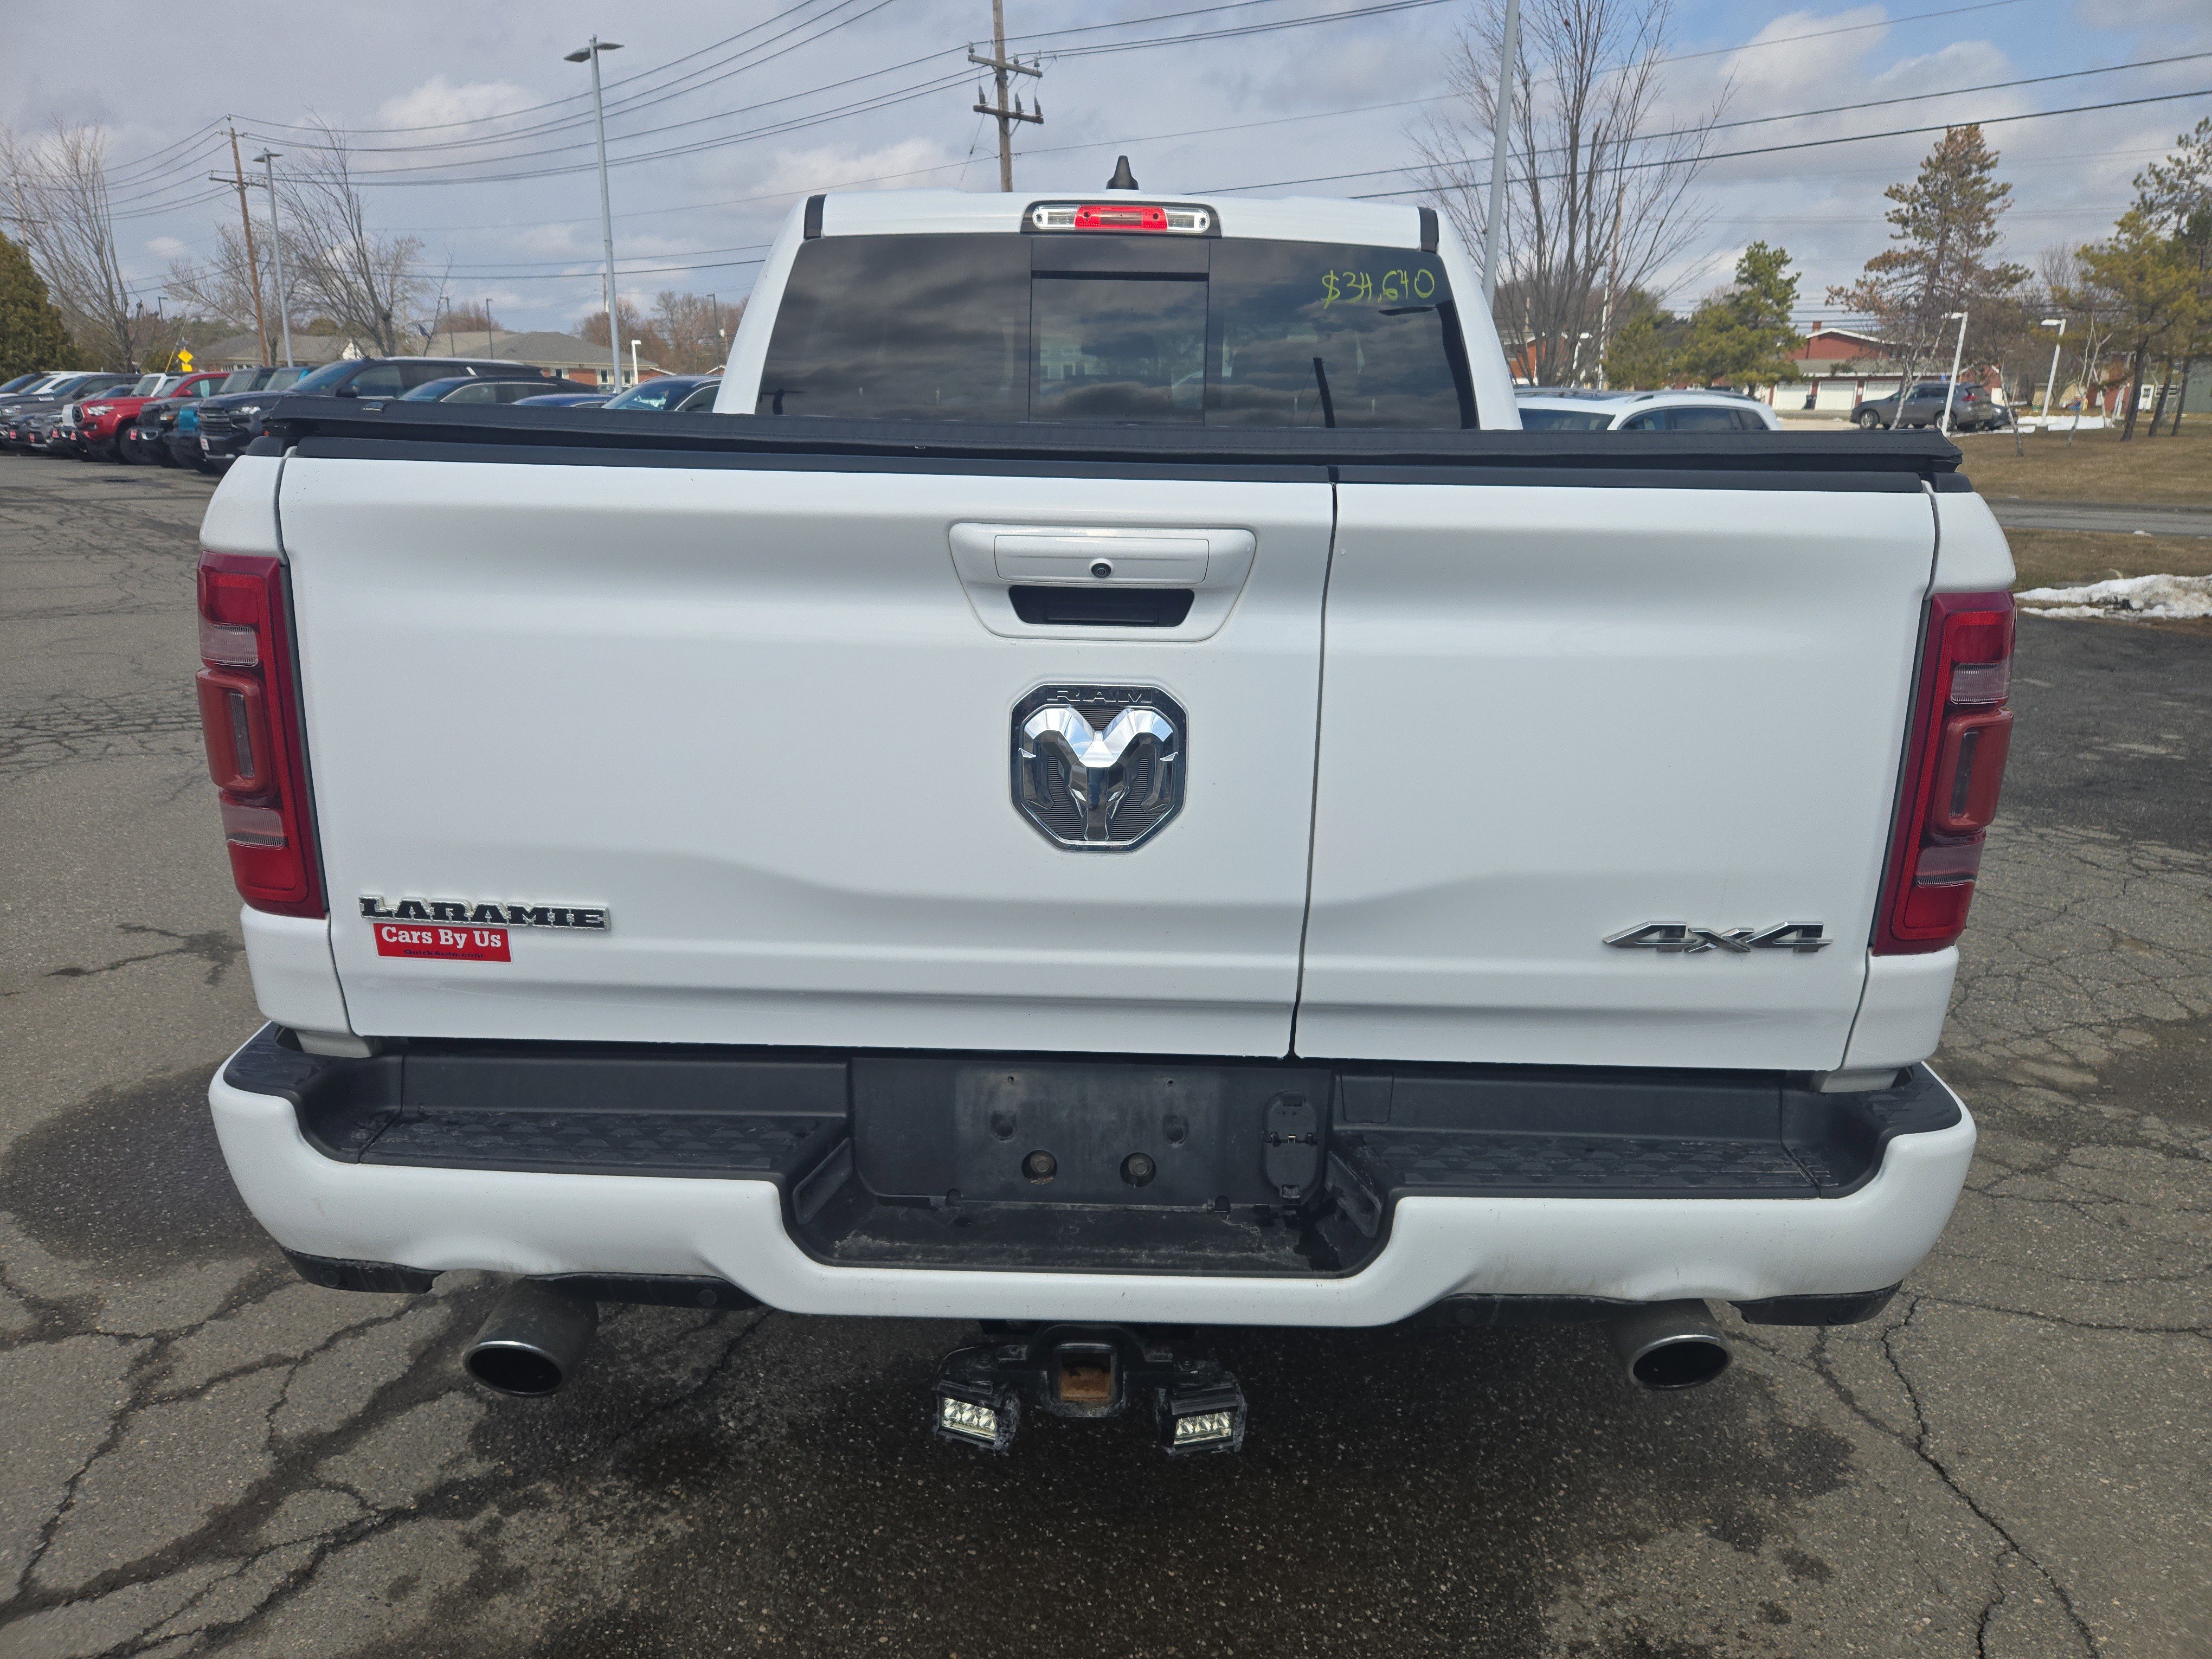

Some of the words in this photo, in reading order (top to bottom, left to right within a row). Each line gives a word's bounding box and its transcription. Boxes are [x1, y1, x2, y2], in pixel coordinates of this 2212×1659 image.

[1046, 687, 1152, 703] RAM
[358, 895, 610, 931] LARAMIE
[381, 925, 433, 944] Cars
[439, 929, 467, 949] By
[472, 931, 501, 948] Us
